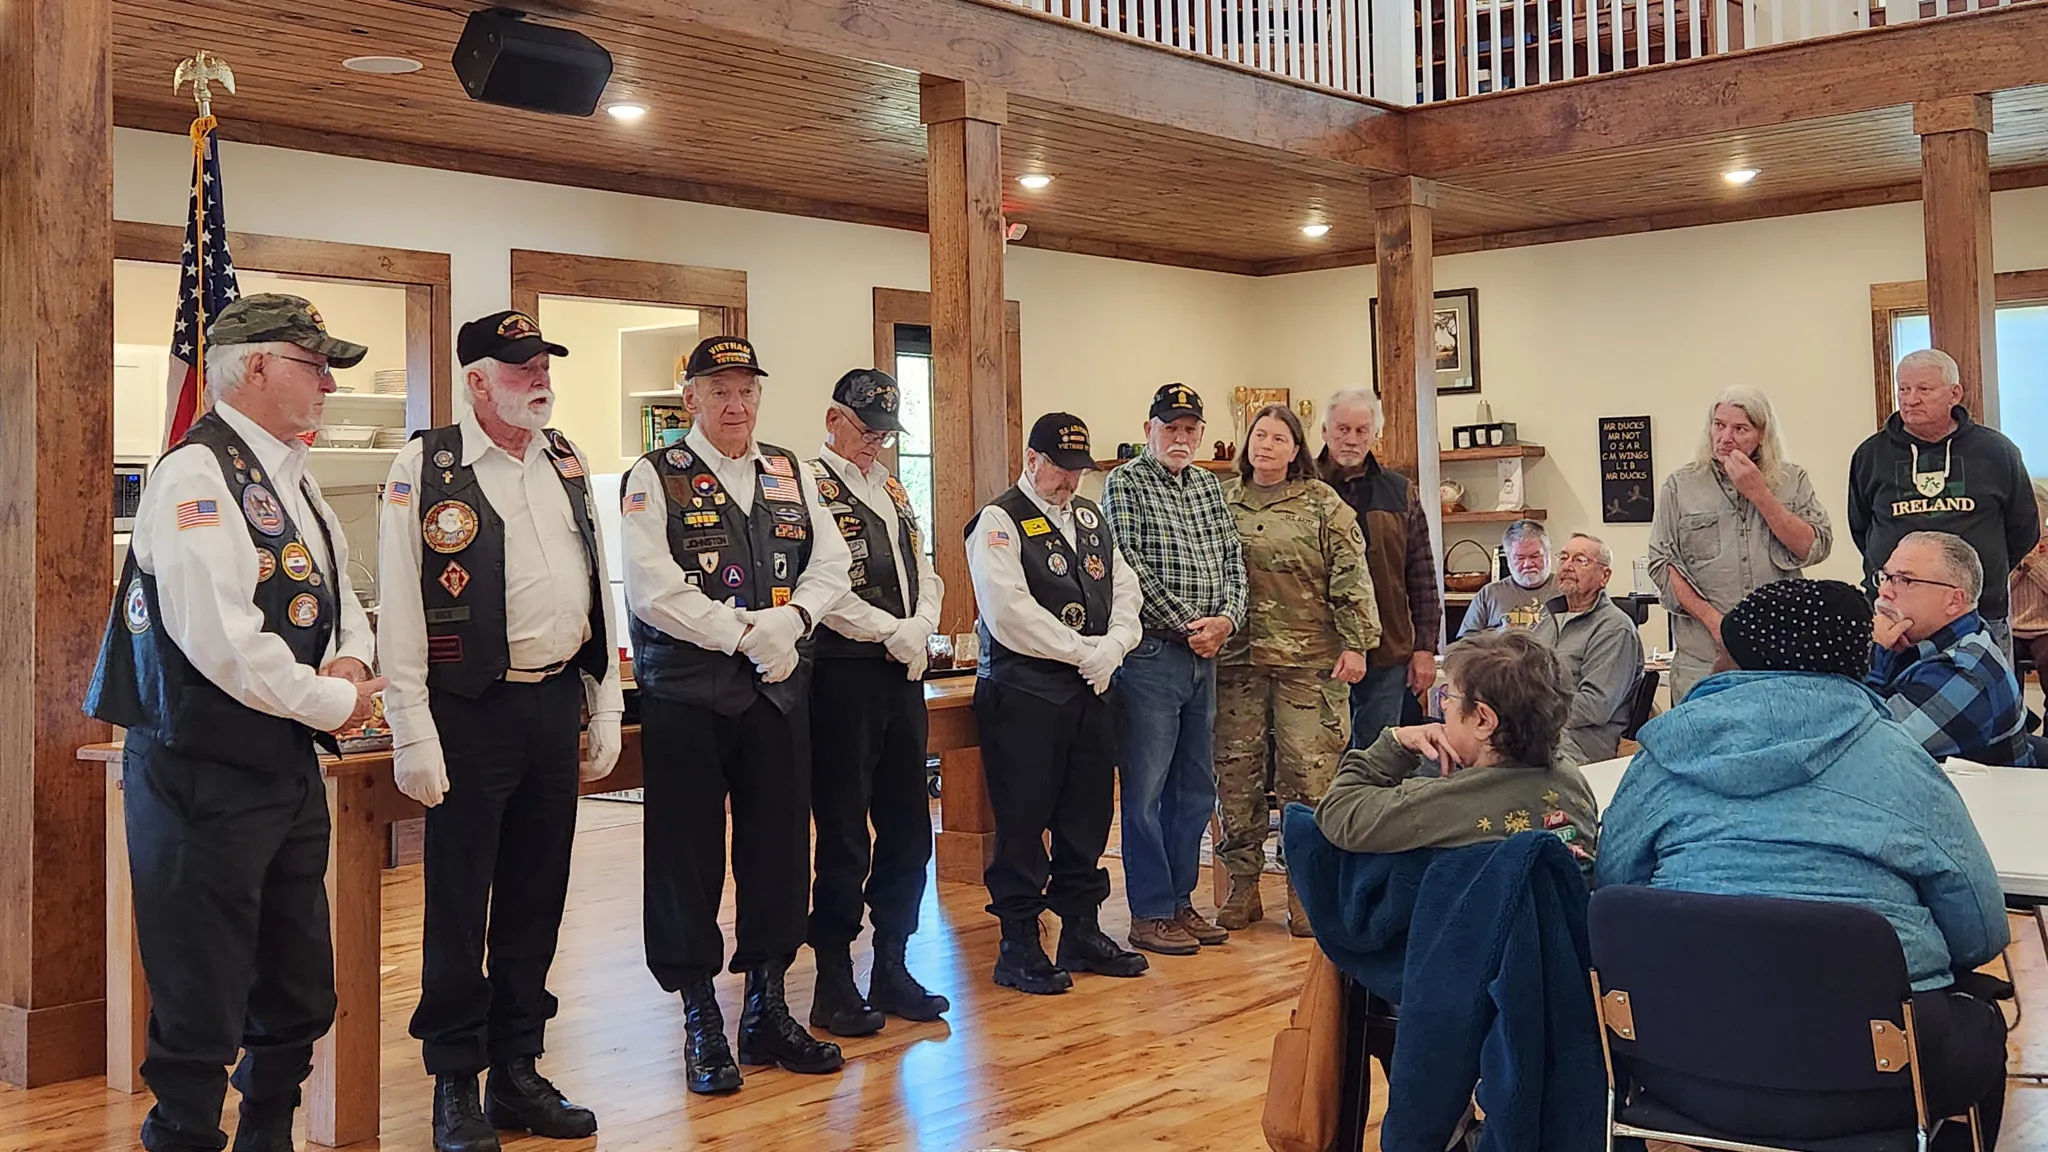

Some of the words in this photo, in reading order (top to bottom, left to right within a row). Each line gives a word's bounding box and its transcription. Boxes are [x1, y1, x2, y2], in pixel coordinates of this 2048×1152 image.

[708, 342, 751, 355] VIETNAM
[1603, 422, 1616, 430] MR
[1617, 421, 1645, 431] DUCKS
[1608, 432, 1620, 440] MR
[1621, 431, 1641, 440] NOT
[1618, 450, 1649, 460] WINGS
[1605, 472, 1618, 480] MR
[1619, 471, 1648, 480] DUCKS
[1891, 497, 1976, 517] IRELAND
[686, 537, 727, 549] JOHNSTON
[728, 567, 741, 583] A
